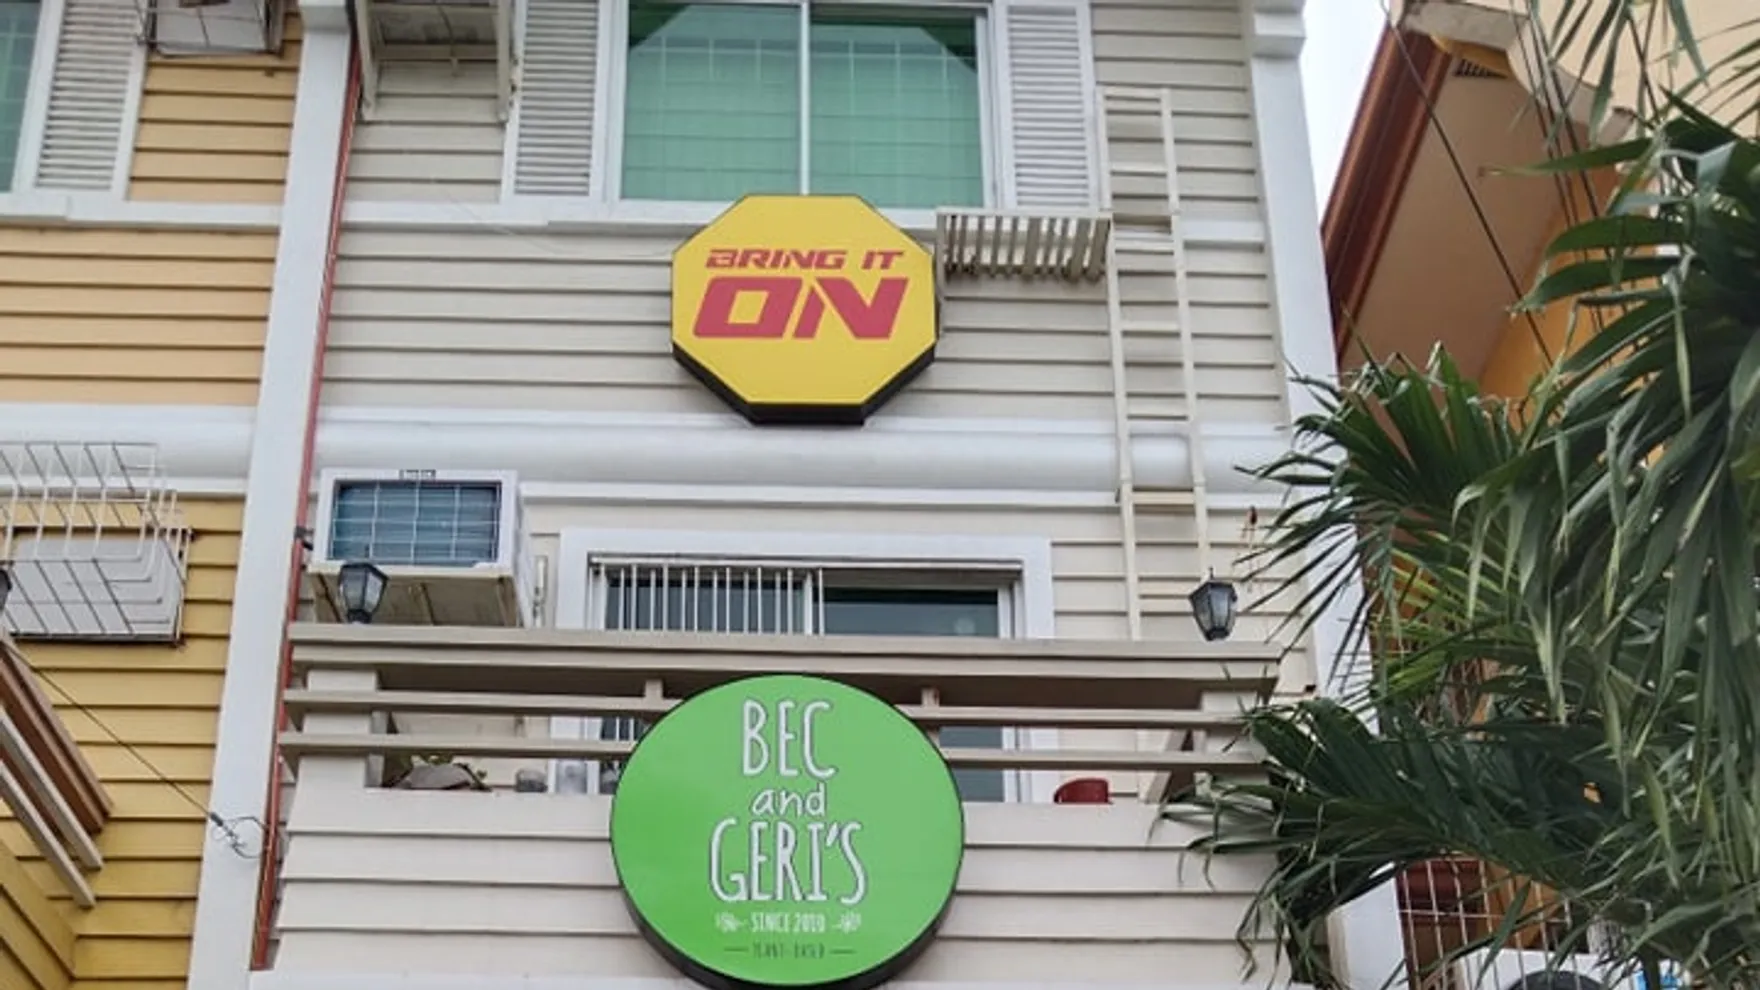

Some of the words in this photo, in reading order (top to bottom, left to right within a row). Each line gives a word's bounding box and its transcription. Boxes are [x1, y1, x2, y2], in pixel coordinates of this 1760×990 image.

[705, 249, 847, 270] BRING
[861, 250, 905, 271] IT
[692, 276, 910, 340] ON
[743, 700, 837, 778] BEC
[752, 782, 825, 816] and
[711, 817, 867, 904] GERI'S
[750, 911, 789, 933] SINCE
